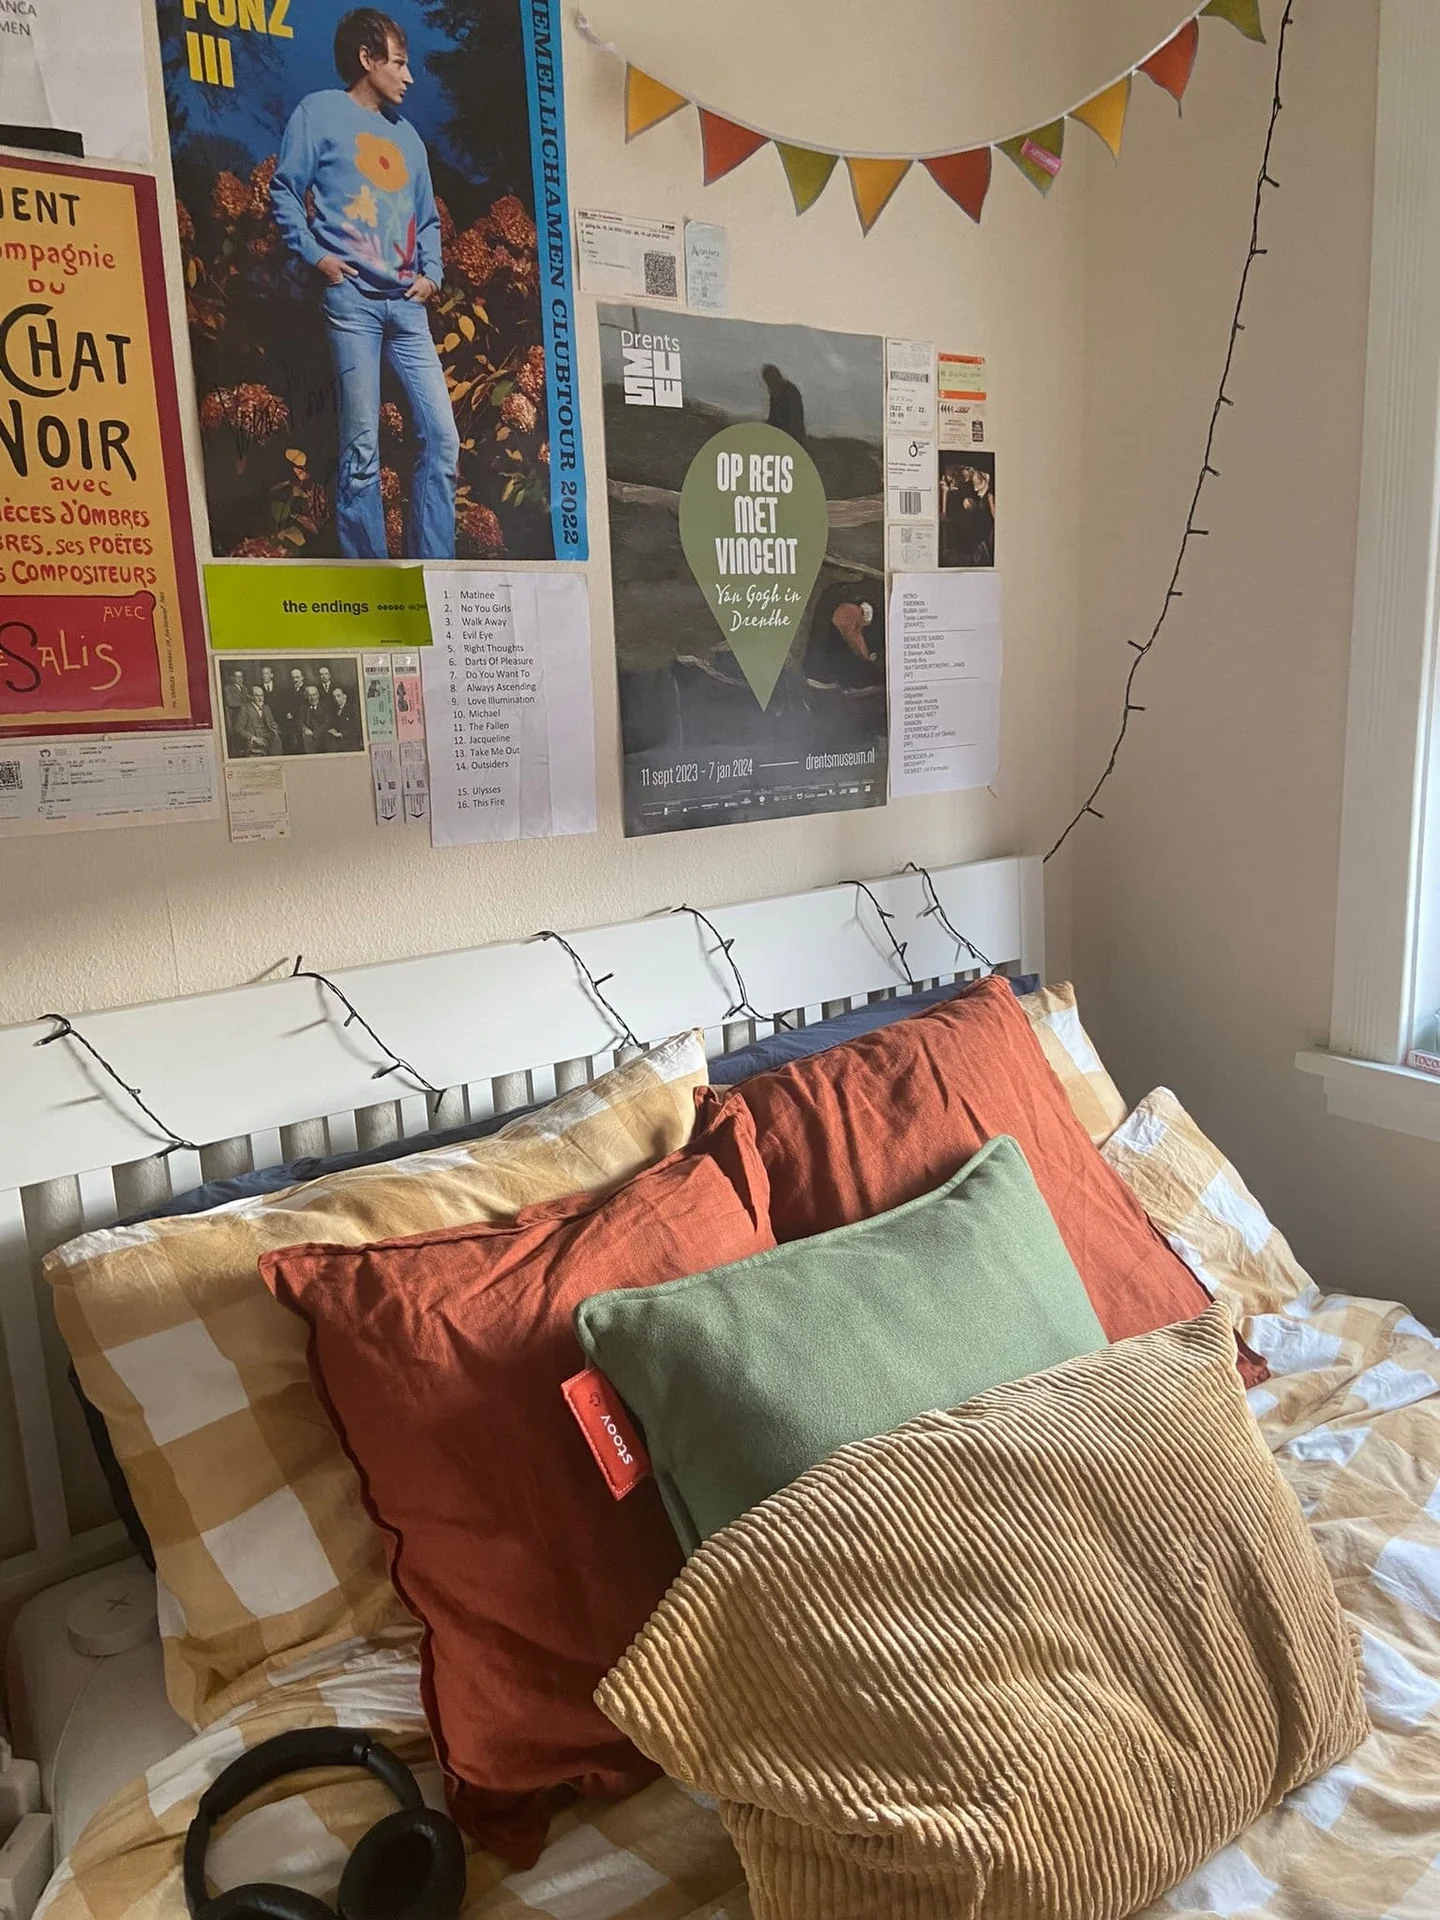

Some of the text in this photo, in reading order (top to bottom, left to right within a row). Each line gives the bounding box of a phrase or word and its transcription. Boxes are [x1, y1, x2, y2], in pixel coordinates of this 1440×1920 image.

[186, 31, 235, 88] III
[0, 242, 116, 275] mpagnie
[28, 278, 66, 295] DU
[621, 330, 680, 352] Drents
[0, 303, 132, 398] CHAT
[552, 299, 576, 471] CLUBTOUR
[716, 451, 794, 494] OP REIS
[50, 476, 112, 497] avec
[560, 481, 579, 545] 2022
[734, 496, 778, 534] MET
[715, 537, 798, 575] VINCENT
[12, 560, 157, 587] COMPOSITEURS
[444, 590, 495, 600] 1. Matinee
[715, 583, 801, 610] Van Gogh in
[103, 606, 146, 622] AVEC
[283, 600, 369, 616] the endings
[444, 604, 511, 613] 2. No You Girls
[445, 617, 507, 628] 3. Walk Away
[729, 608, 791, 632] Drenthe
[446, 631, 494, 642] 4. Evil Eye
[447, 644, 524, 655] 5. Right Thoughts
[449, 656, 534, 666] 6. Darts Of Pleasure
[450, 670, 530, 680] 7. Do You Want To
[450, 683, 537, 694] 8. Always Ascending
[451, 696, 535, 706] 9. Love Illumination
[453, 709, 501, 719] 10. Michael
[453, 721, 510, 732] 11. The Fallen
[454, 734, 511, 745] 12. Jacqueline
[454, 746, 520, 758] 13. Take Me Out
[805, 747, 875, 771] drentsmuseum.nl
[456, 760, 509, 771] 14. Outsiders
[641, 768, 650, 786] 11
[652, 767, 674, 788] sept
[676, 763, 698, 783] 2023
[709, 761, 715, 780] 7
[716, 761, 731, 783] jan
[732, 758, 753, 777] 2024
[457, 785, 501, 796] 15. Ulysses
[457, 798, 505, 809] 16. This Fire
[600, 1414, 634, 1465] stoov
